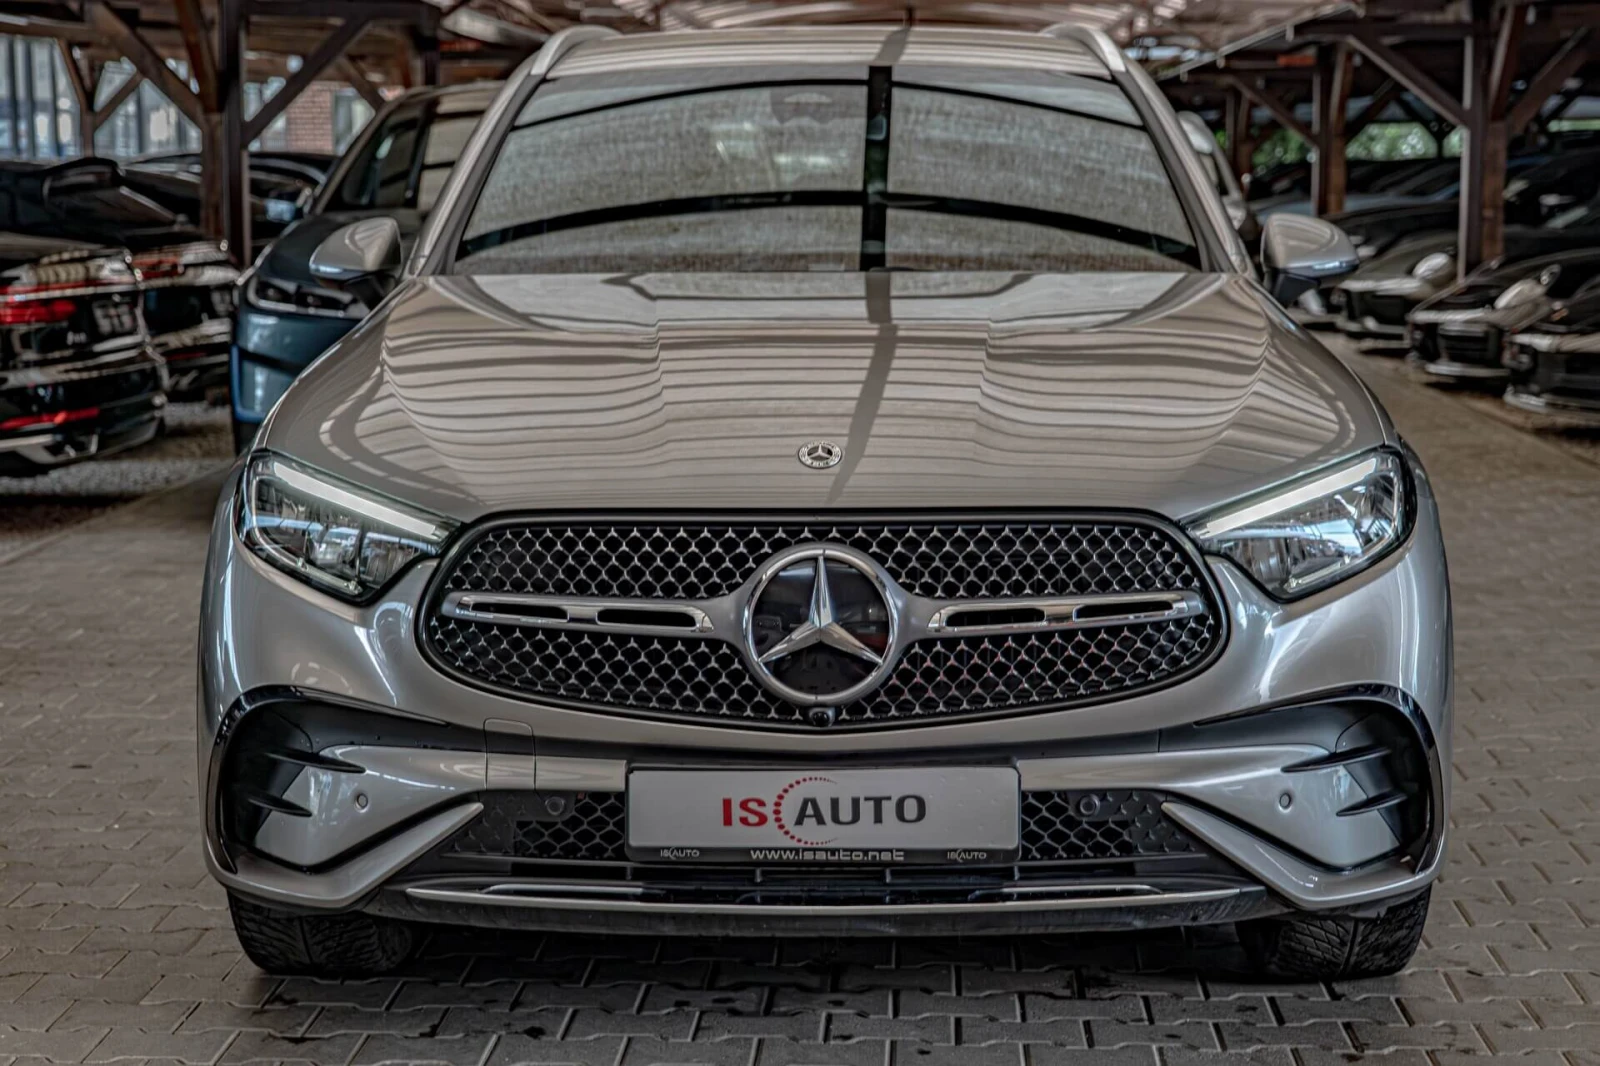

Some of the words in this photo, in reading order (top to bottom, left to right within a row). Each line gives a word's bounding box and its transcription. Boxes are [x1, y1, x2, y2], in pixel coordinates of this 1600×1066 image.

[722, 796, 768, 827] IS
[793, 794, 927, 827] AUTO
[750, 849, 905, 861] www.isauto.net
